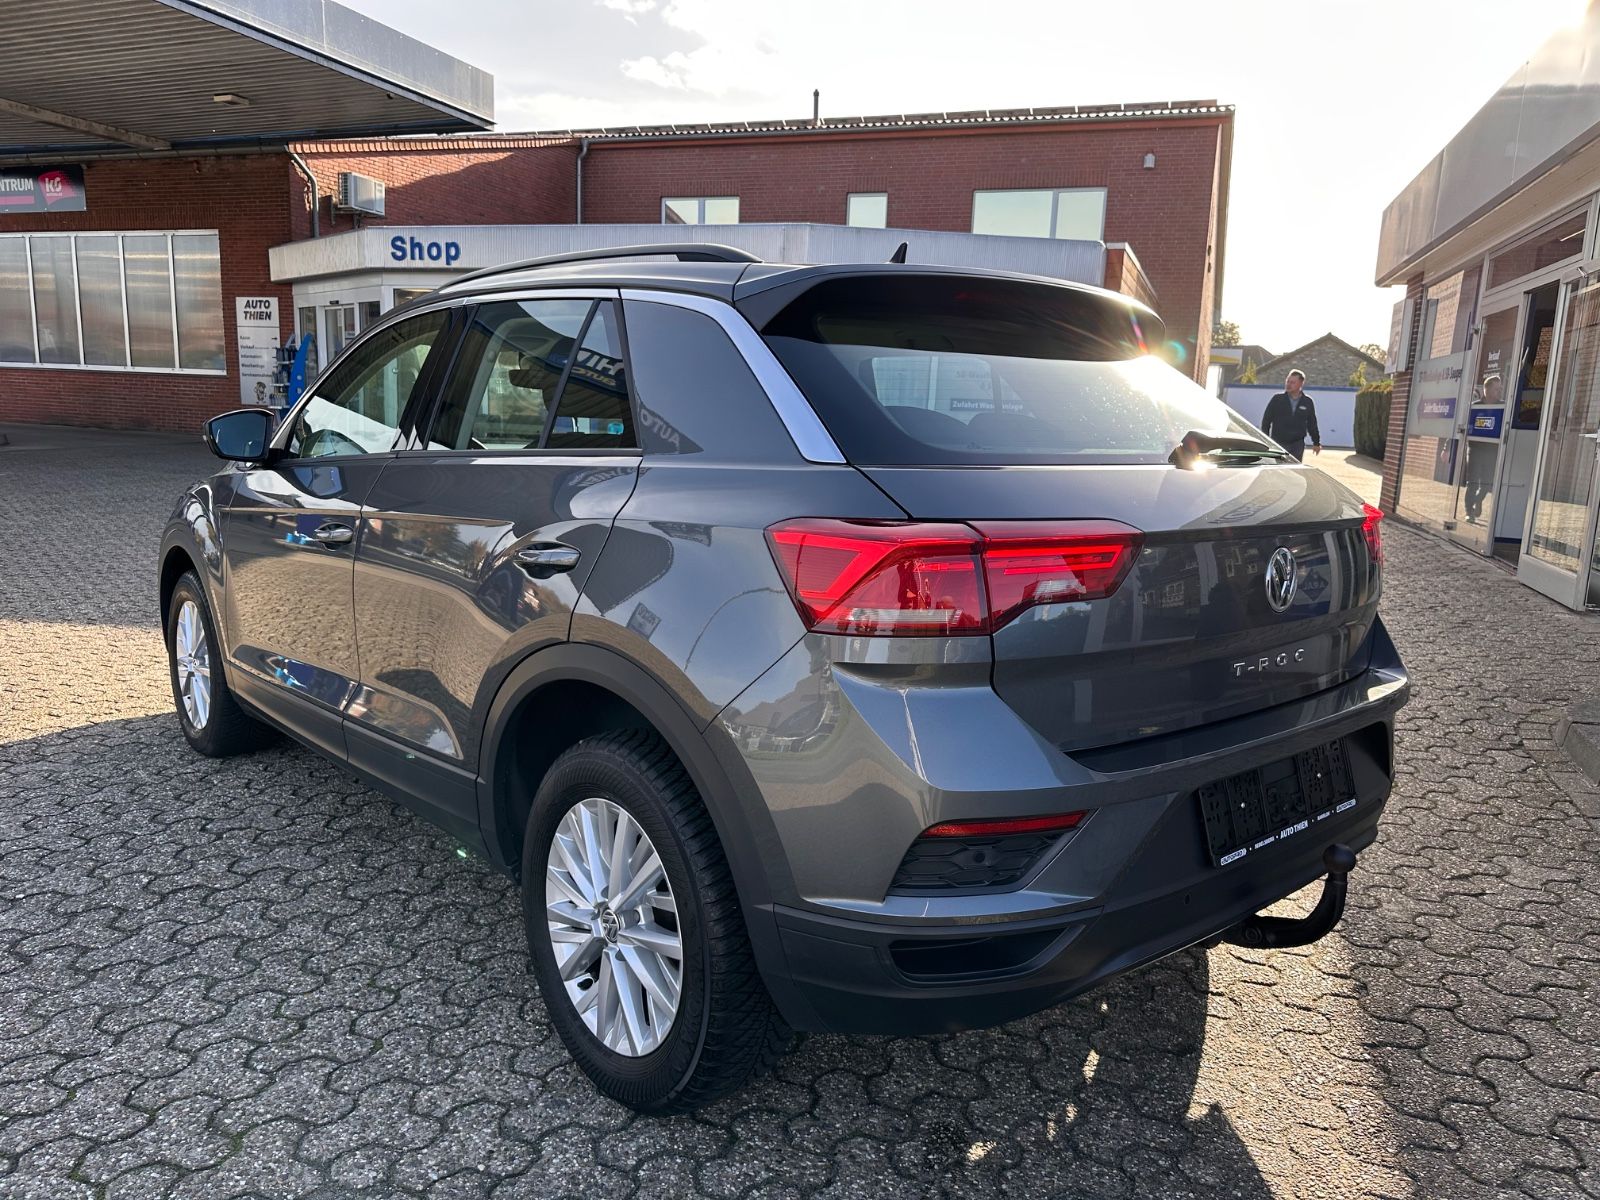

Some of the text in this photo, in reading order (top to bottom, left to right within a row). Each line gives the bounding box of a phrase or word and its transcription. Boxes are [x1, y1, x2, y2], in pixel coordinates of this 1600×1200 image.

[391, 236, 460, 265] Shop
[244, 300, 271, 309] AUTO
[243, 311, 272, 320] THIEN
[1280, 826, 1294, 839] AUTO
[1294, 820, 1308, 833] THIEN
